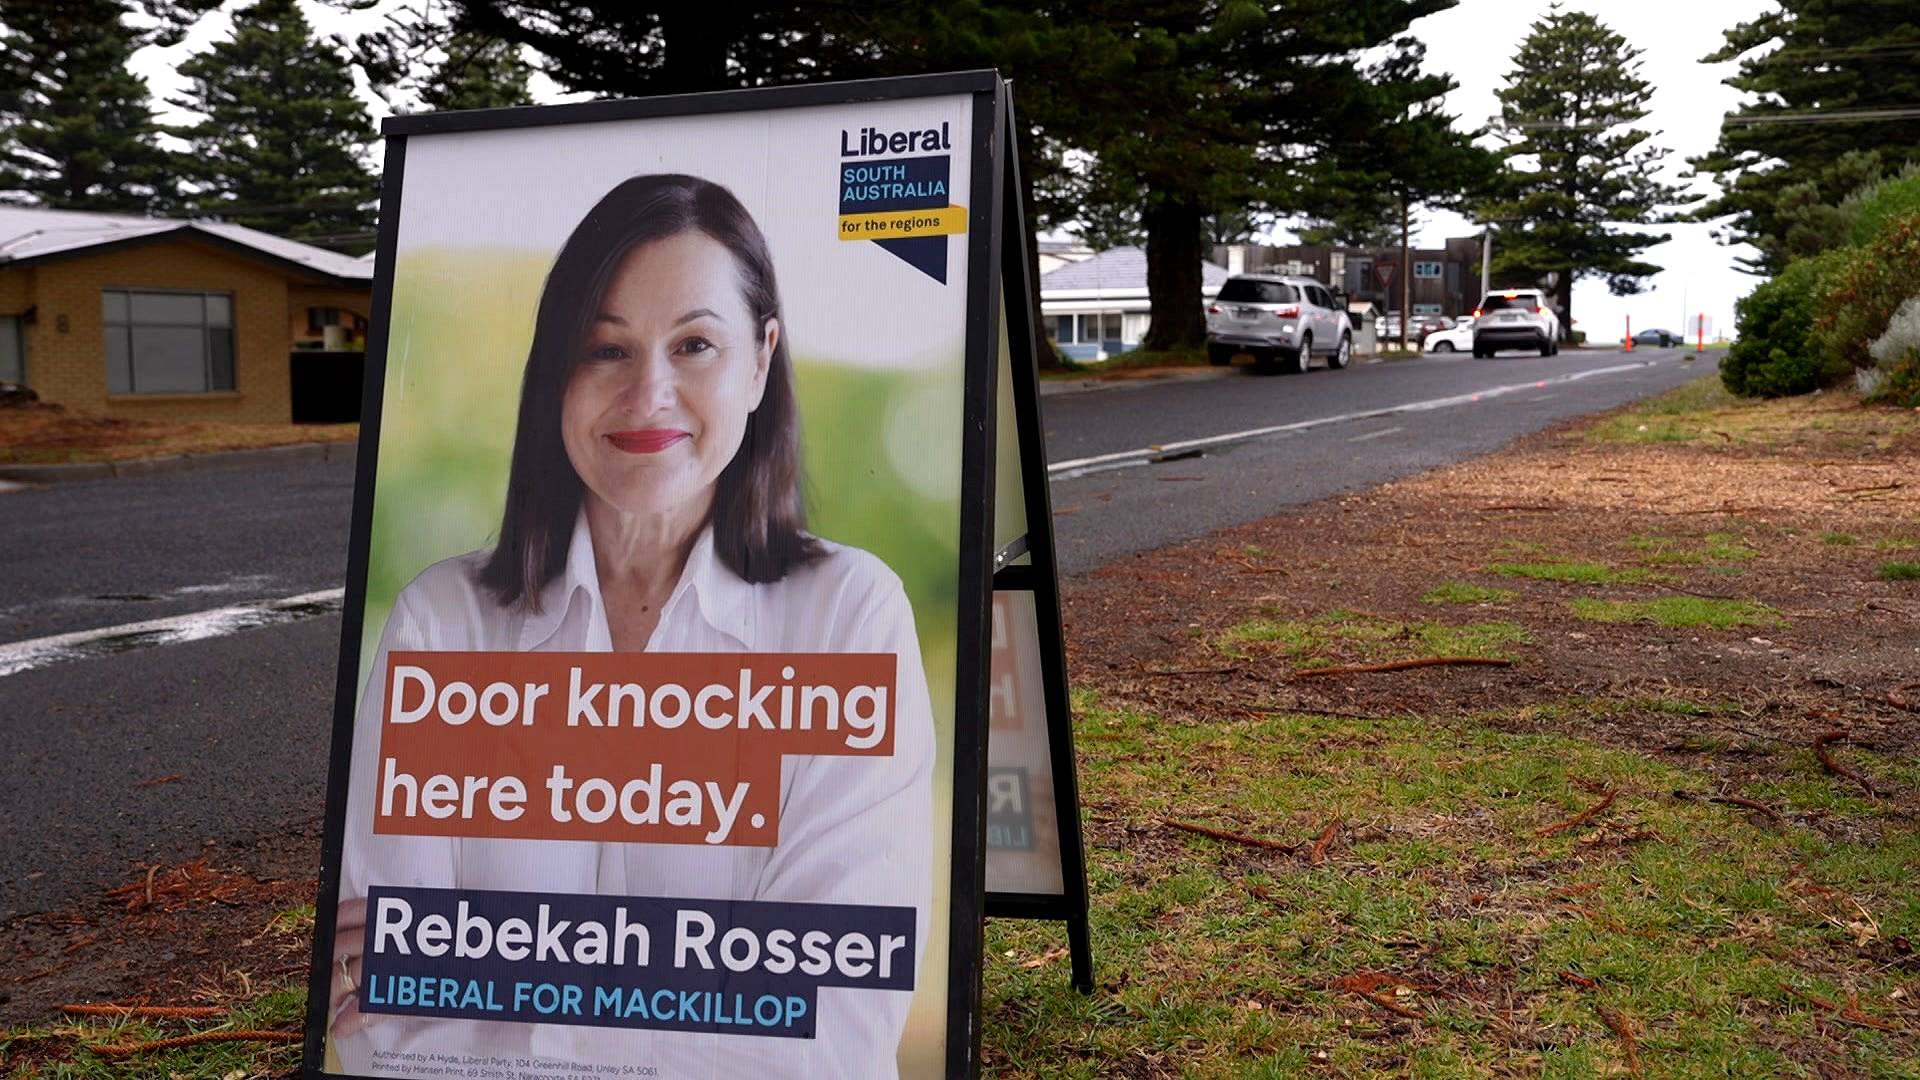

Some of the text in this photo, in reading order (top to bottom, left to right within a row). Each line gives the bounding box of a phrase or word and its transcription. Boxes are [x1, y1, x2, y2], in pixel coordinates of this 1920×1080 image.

[841, 122, 951, 157] Liberal
[843, 165, 906, 184] SOUTH
[843, 180, 946, 202] AUSTRALIA
[841, 217, 940, 233] for the regions
[390, 665, 888, 750] Door knocking
[381, 758, 765, 846] here today.
[373, 896, 906, 978] Rebekah Rosser
[368, 974, 807, 1027] LIBERAL FOR MACKILLOP
[371, 1061, 400, 1072] Printed
[401, 1064, 412, 1075] by
[372, 1049, 416, 1061] Authorised
[417, 1053, 428, 1064] by
[429, 1053, 436, 1062] A
[462, 1055, 488, 1066] Liberal
[622, 1064, 635, 1075] SA
